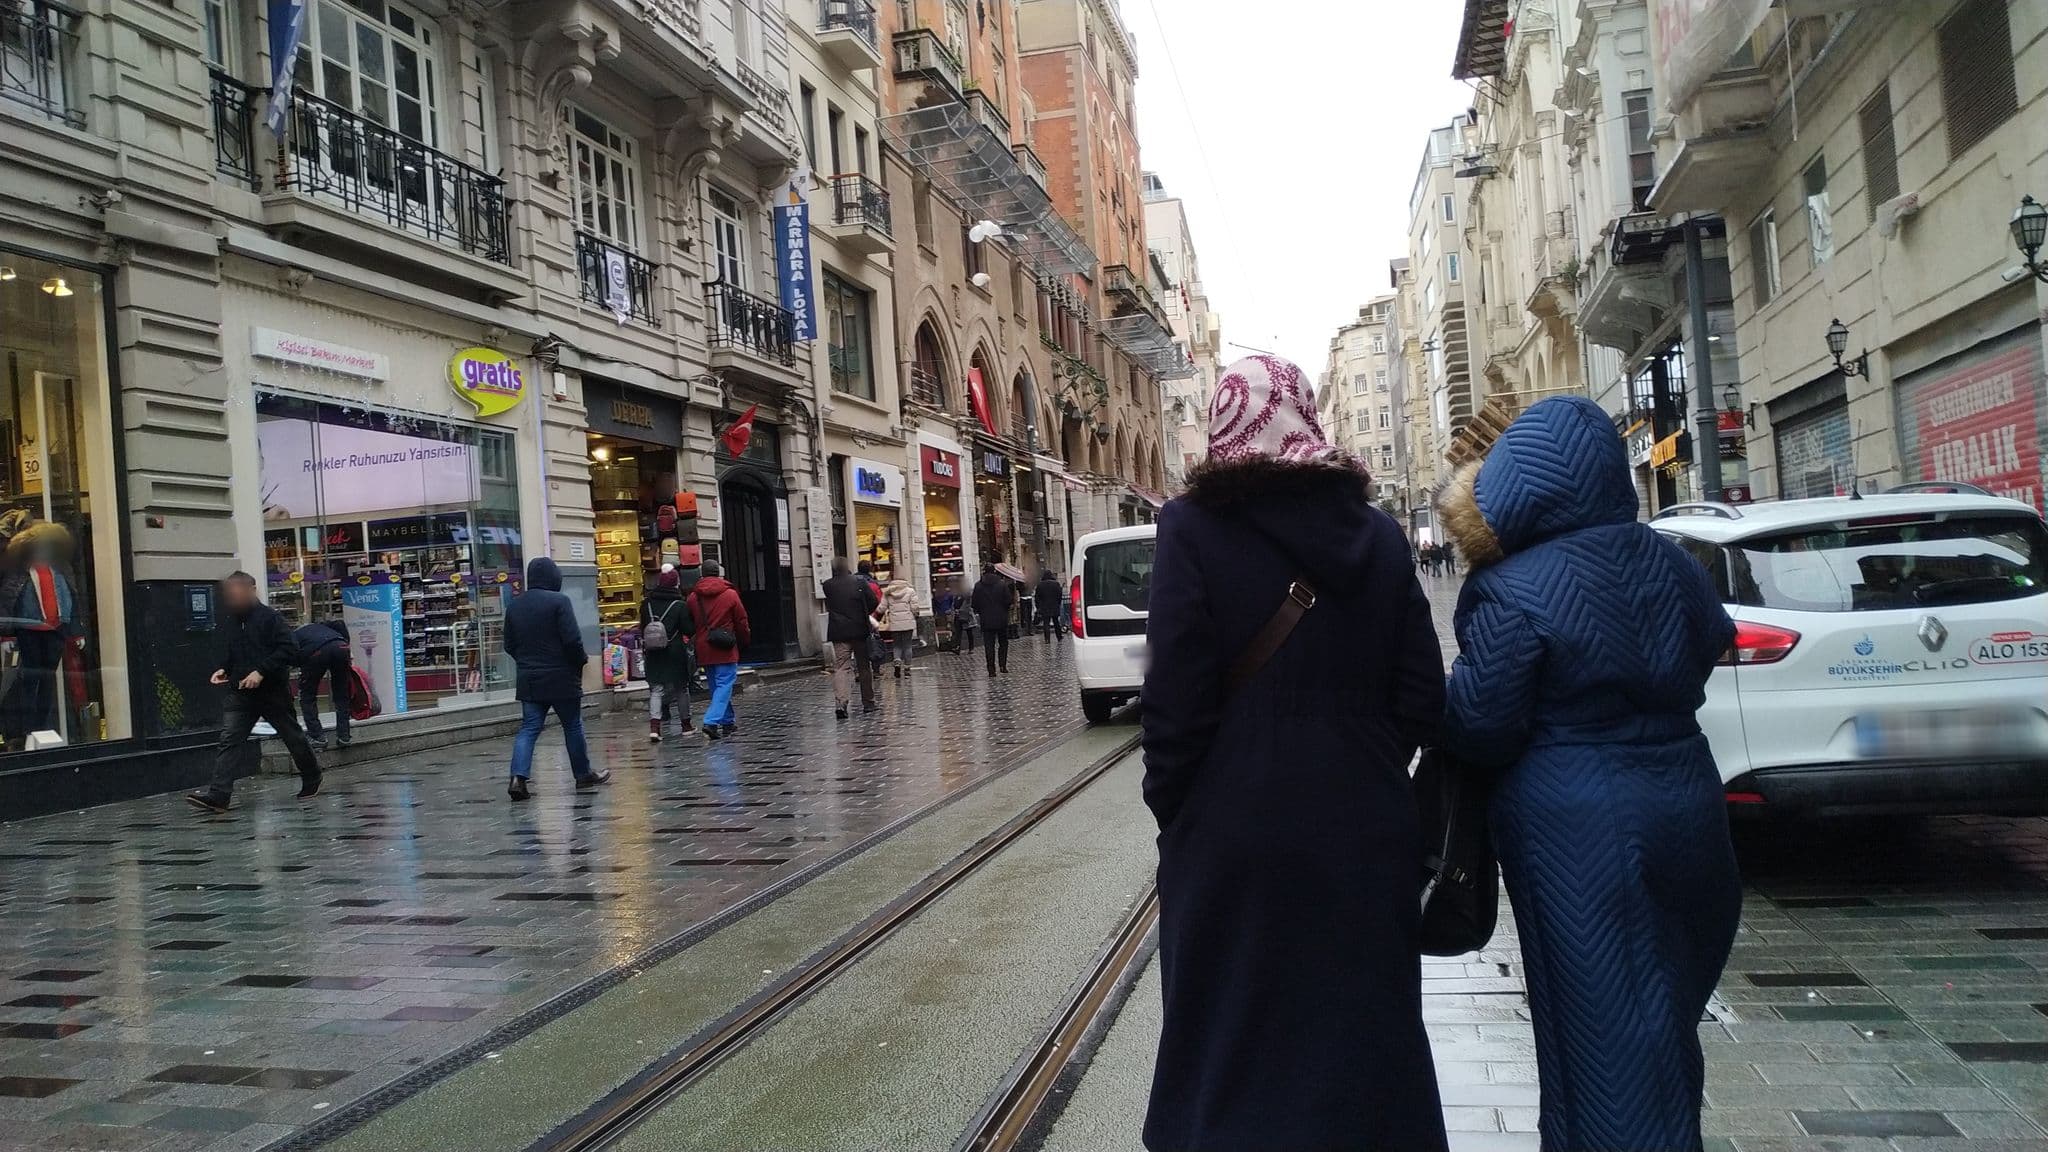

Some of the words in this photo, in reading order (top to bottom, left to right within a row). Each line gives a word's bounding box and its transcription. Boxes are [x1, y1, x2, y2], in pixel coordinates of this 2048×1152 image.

[786, 205, 804, 281] MARMARA
[793, 288, 808, 340] LOKAL
[464, 359, 522, 390] gratis
[303, 457, 346, 473] Renkler
[349, 451, 407, 468] Ruhunuzu
[1932, 424, 2021, 483] KİRALIK
[24, 460, 40, 473] 30
[372, 521, 464, 537] MAYBELLINE
[346, 590, 380, 604] Venus
[1978, 644, 2014, 660] ALO
[2021, 642, 2048, 657] 153
[1828, 663, 1903, 677] BÜYÜKŞEHİR
[1903, 658, 1969, 672] CLIO
